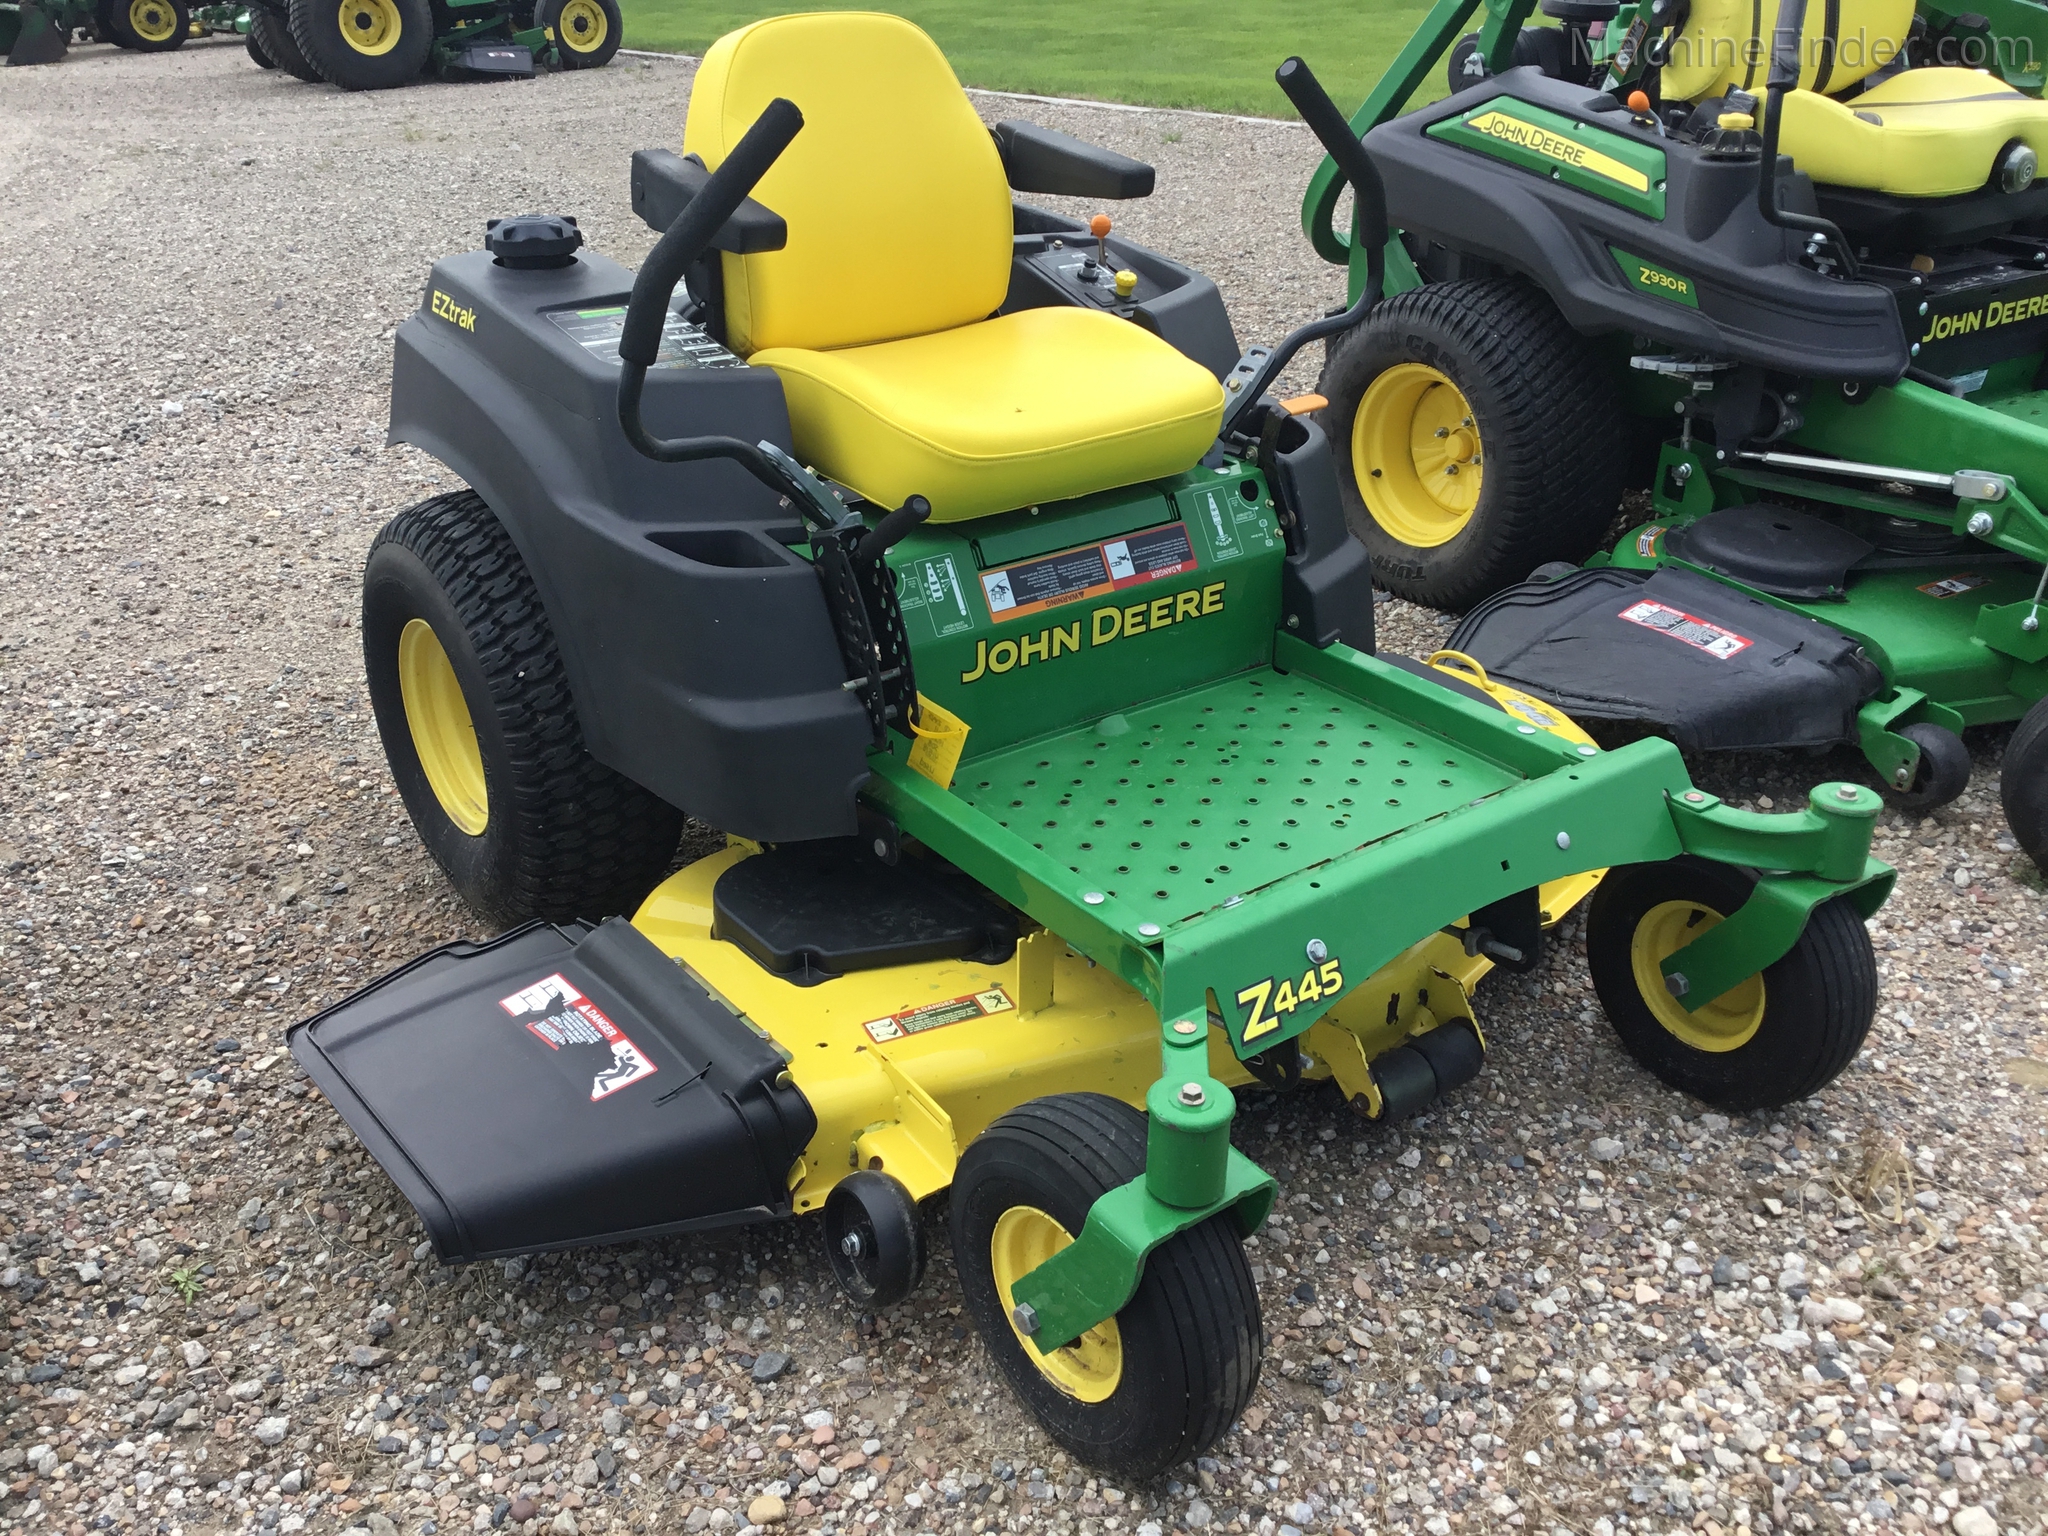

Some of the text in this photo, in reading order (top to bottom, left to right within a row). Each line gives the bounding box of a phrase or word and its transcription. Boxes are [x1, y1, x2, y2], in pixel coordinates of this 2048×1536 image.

[1483, 115, 1586, 164] JOHN DEERE
[1639, 266, 1687, 294] Z930R
[431, 289, 477, 333] EZtrak
[1922, 309, 1983, 343] JOHN
[1150, 565, 1176, 578] DANGER
[1044, 592, 1078, 607] WARNING
[961, 581, 1226, 684] JOHN DEERE
[920, 999, 956, 1013] DANGER
[1235, 957, 1343, 1046] Z445
[585, 1009, 617, 1037] DANGER
